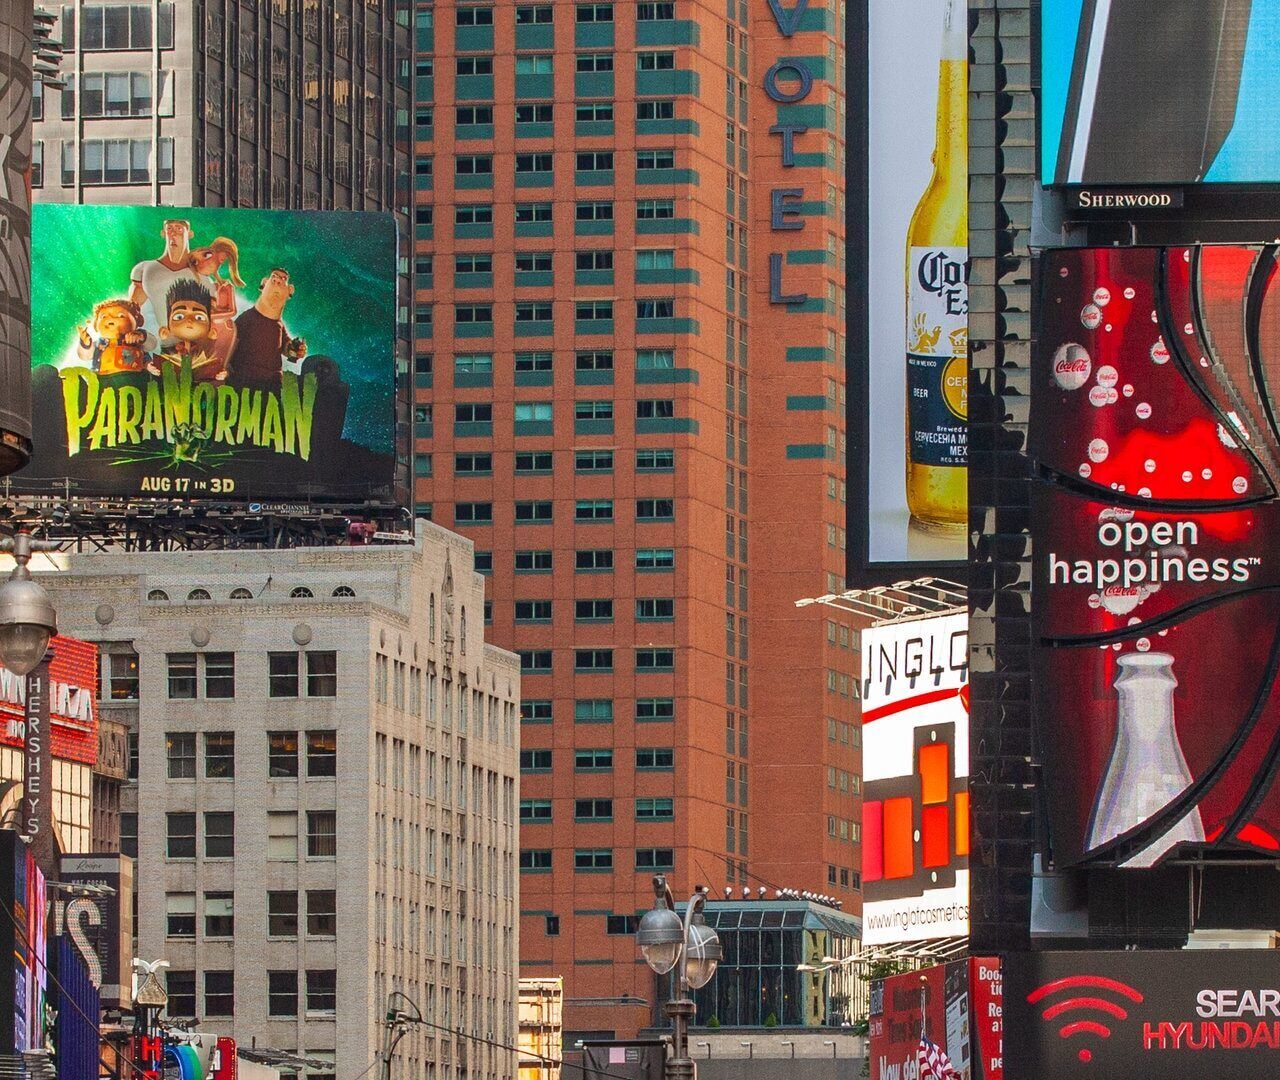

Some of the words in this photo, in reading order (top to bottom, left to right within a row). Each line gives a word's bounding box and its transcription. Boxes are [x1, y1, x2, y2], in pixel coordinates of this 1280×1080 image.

[1078, 191, 1172, 208] SHERWOOD
[913, 388, 929, 398] BEER
[141, 476, 171, 492] AUG
[174, 477, 190, 492] 17
[194, 480, 207, 489] IN
[210, 477, 235, 493] 3D
[1098, 519, 1198, 551] open
[1142, 1020, 1280, 1050] HYUNDAI
